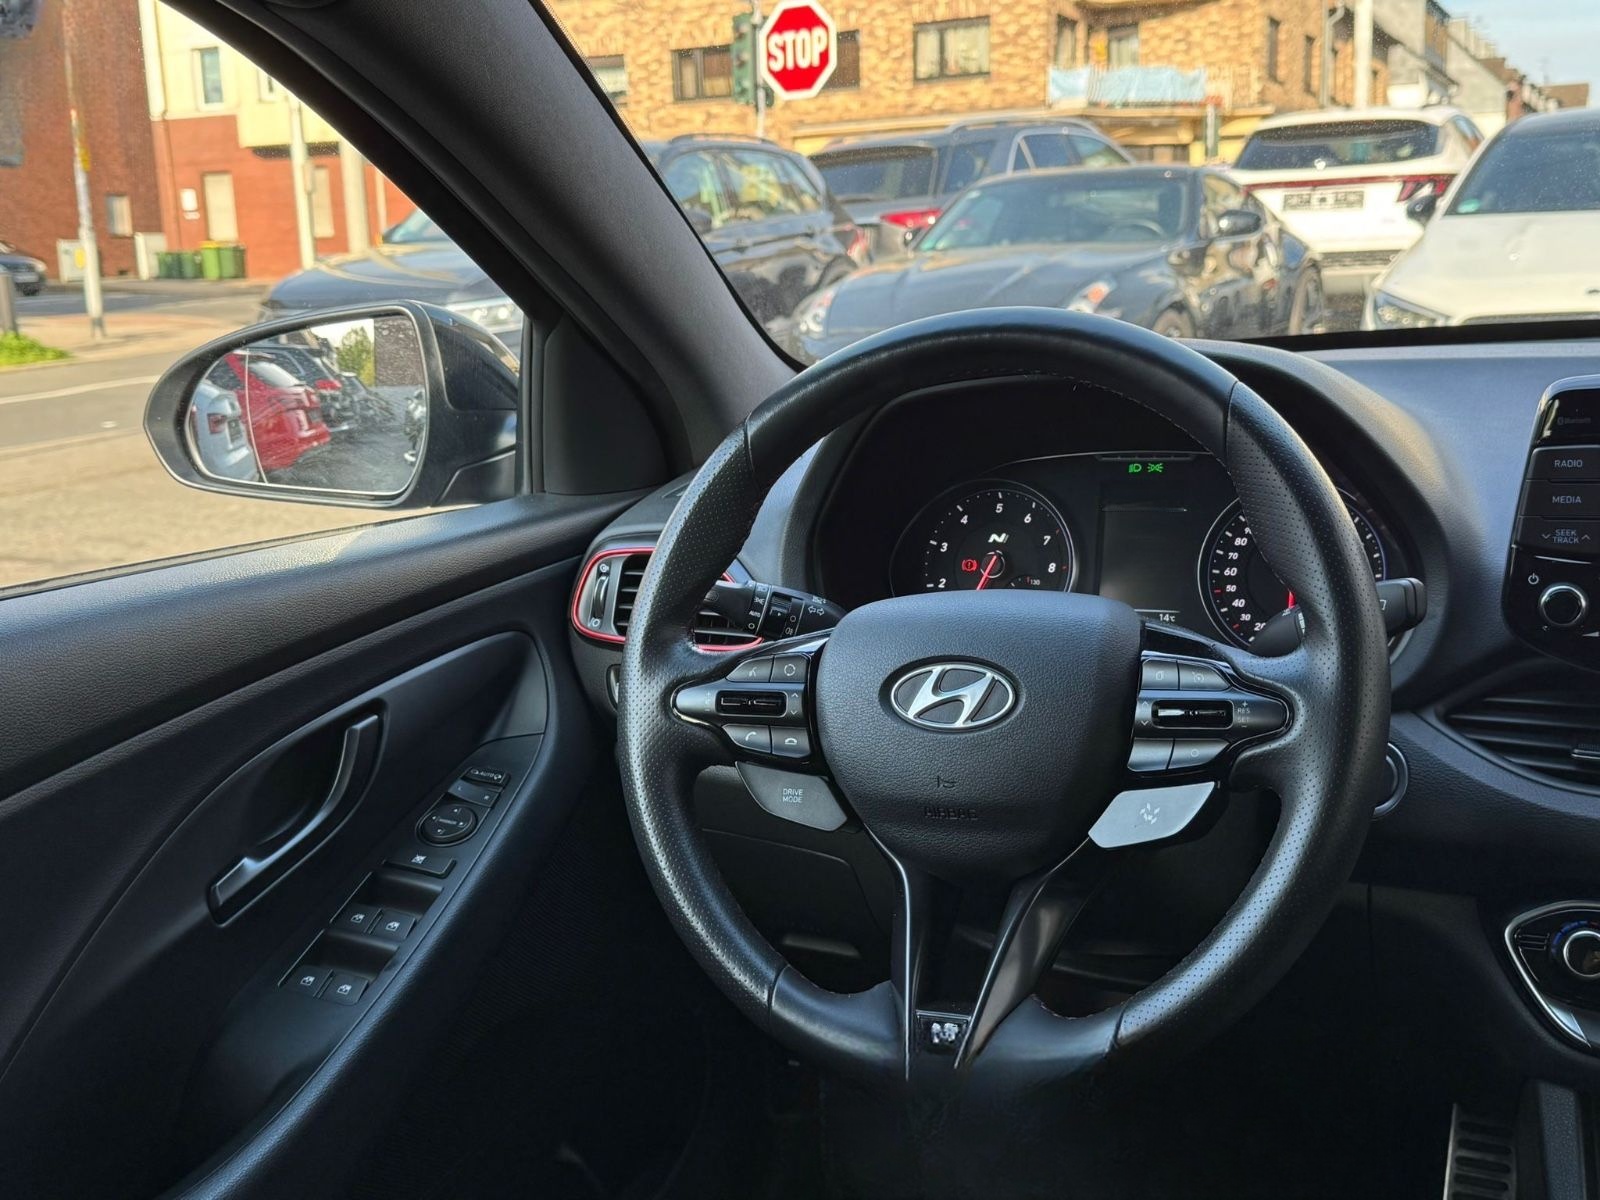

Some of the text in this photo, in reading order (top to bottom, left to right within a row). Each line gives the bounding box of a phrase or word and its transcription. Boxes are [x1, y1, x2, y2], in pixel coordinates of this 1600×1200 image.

[767, 27, 828, 71] STOP
[1554, 459, 1583, 468] RADIO
[1552, 495, 1582, 504] MEDIA
[995, 503, 1003, 513] 5
[960, 514, 968, 524] 4
[1023, 513, 1032, 523] 6
[1555, 529, 1577, 537] SEEK
[1043, 535, 1051, 545] 7
[1234, 537, 1247, 546] 80
[1553, 536, 1580, 544] TRACK
[940, 542, 948, 552] 3
[1228, 552, 1239, 560] 70
[1048, 562, 1056, 573] 8
[1224, 567, 1237, 576] 60
[938, 578, 946, 588] 2
[1232, 599, 1245, 608] 40
[1240, 613, 1252, 621] 30
[782, 788, 804, 796] DRIVE
